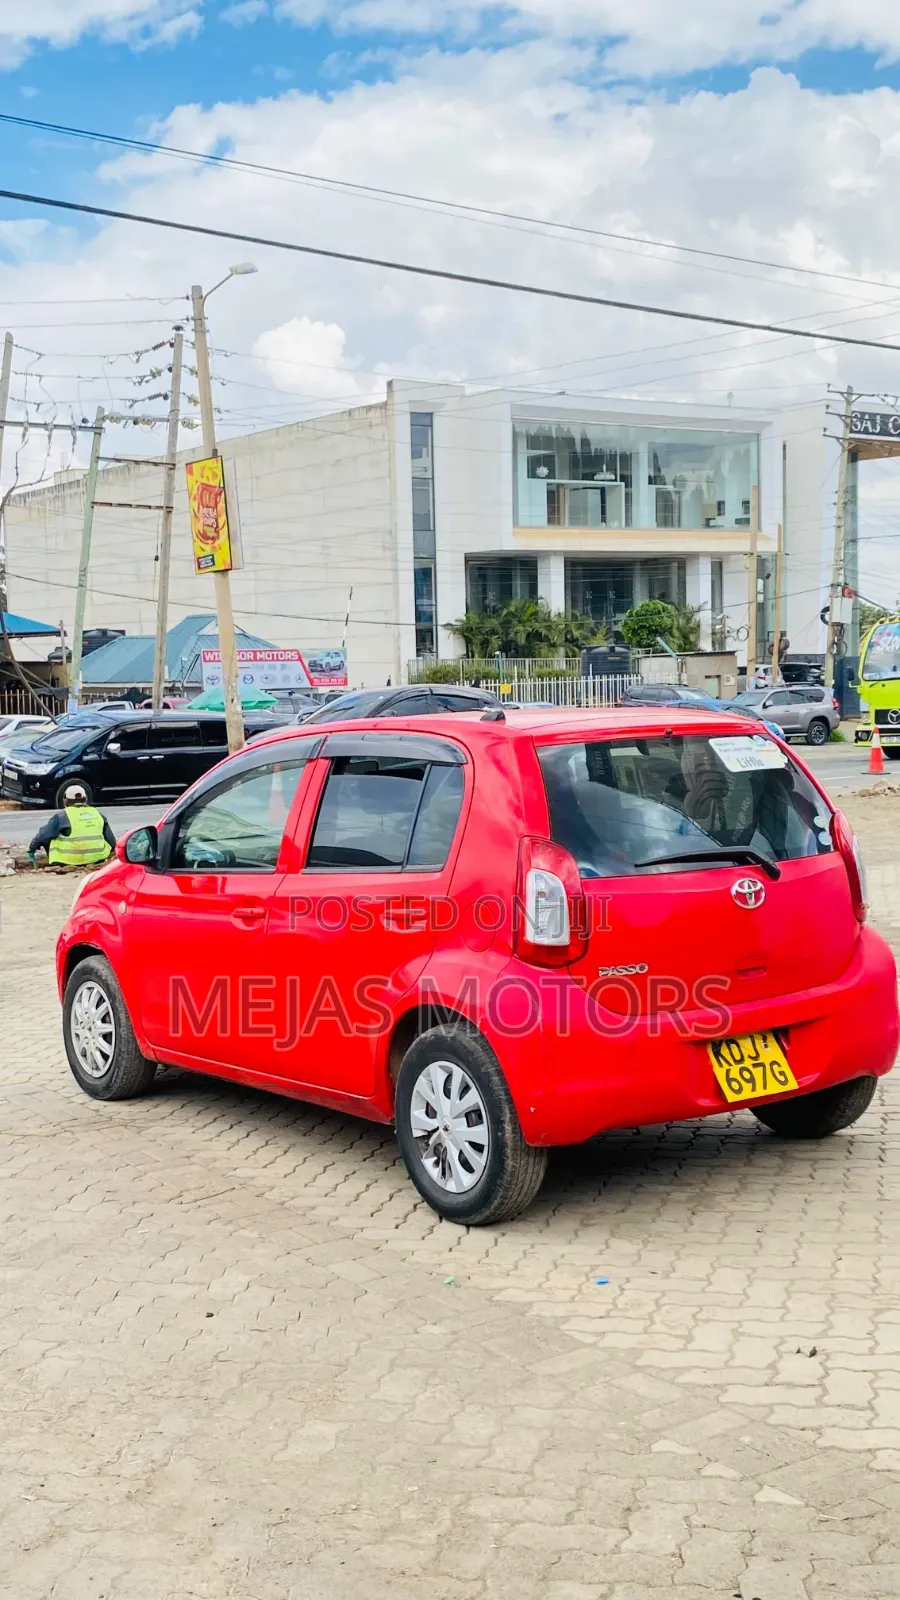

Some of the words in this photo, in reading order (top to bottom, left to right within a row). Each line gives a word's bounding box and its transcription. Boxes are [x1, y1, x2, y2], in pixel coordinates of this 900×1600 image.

[204, 651, 254, 661] WISOR
[256, 651, 299, 661] MOTORS
[598, 963, 649, 977] PASSO
[711, 1034, 761, 1068] KDJ
[726, 1060, 789, 1095] 697G
